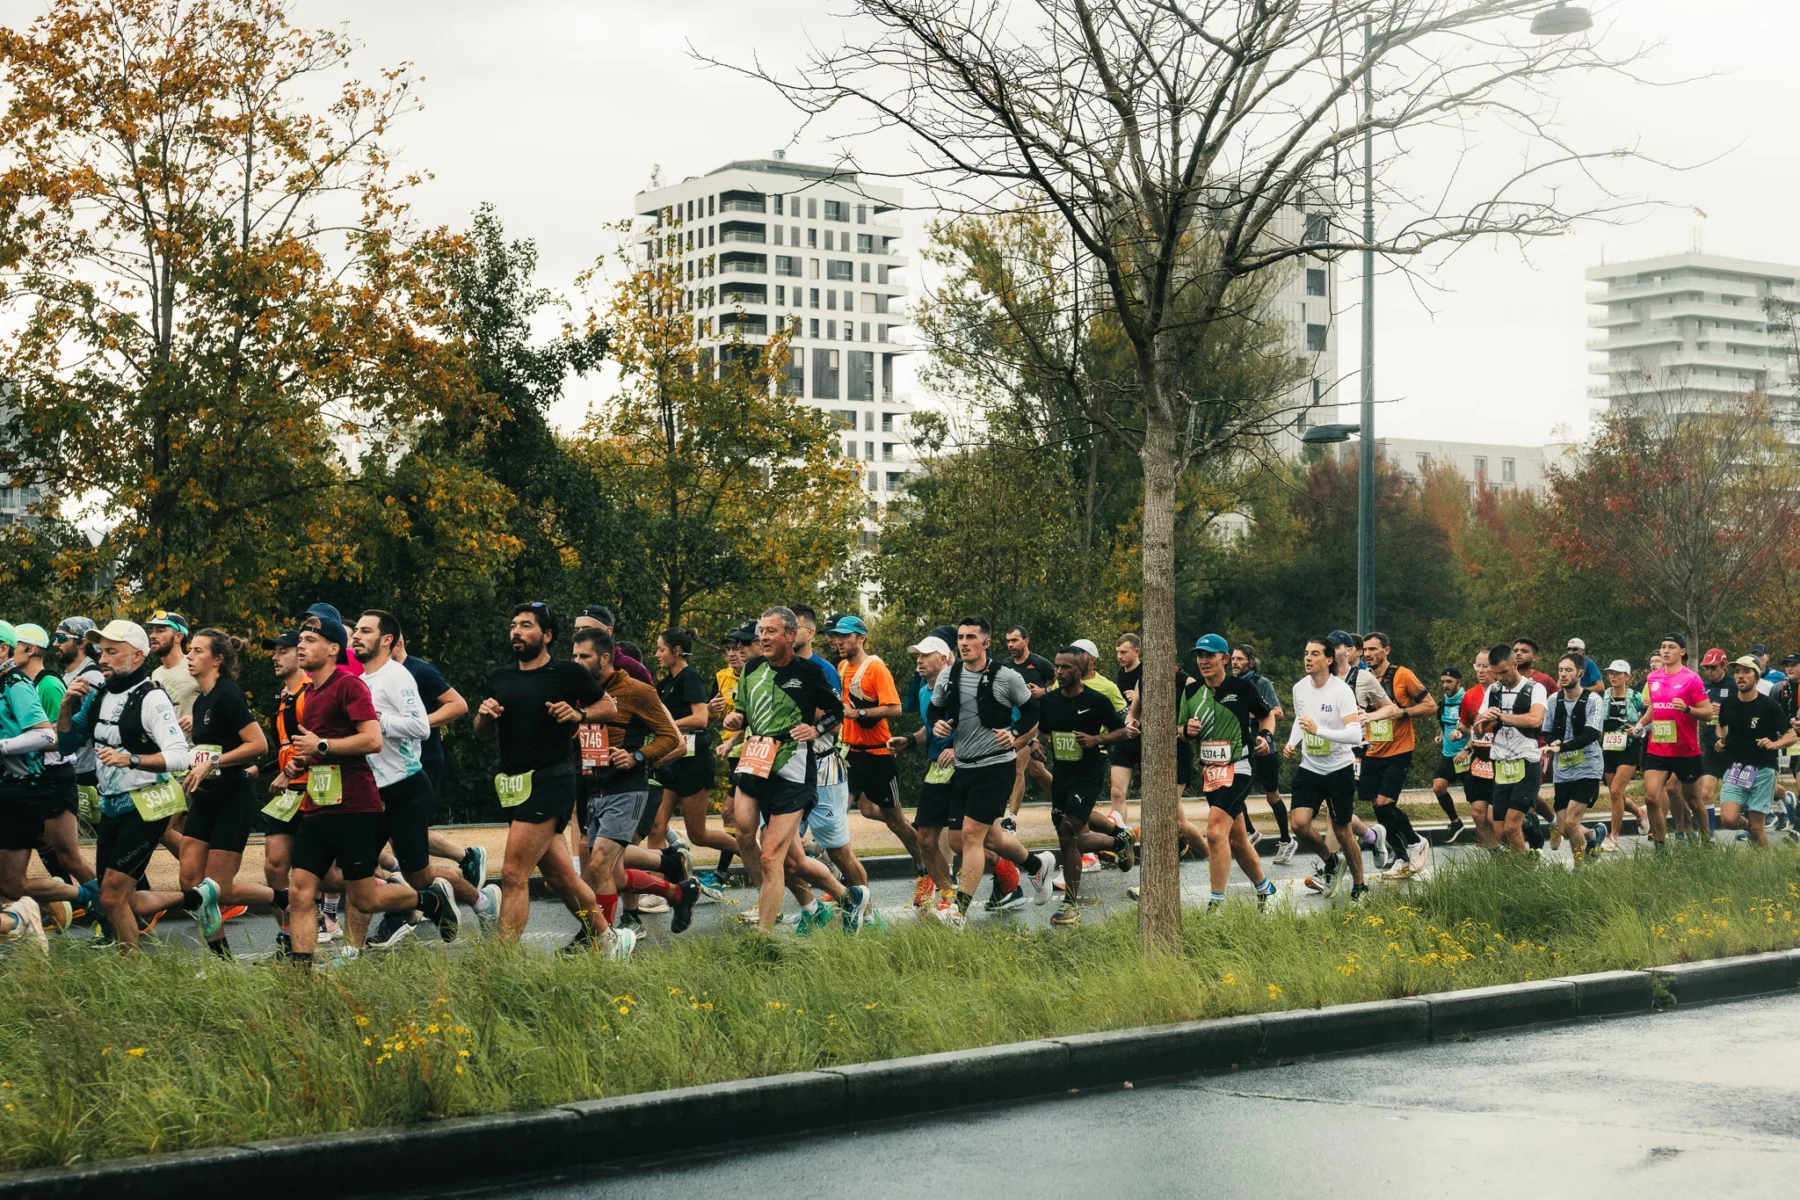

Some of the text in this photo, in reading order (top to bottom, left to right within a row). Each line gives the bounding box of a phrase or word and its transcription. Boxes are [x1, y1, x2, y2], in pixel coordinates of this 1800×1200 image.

[579, 731, 602, 749] 6746
[1056, 737, 1075, 751] 5712
[745, 741, 771, 759] 6370
[1201, 748, 1226, 759] 6374-A
[1206, 766, 1229, 782] 6374
[1501, 762, 1520, 775] 4913
[499, 774, 523, 794] 5140
[141, 784, 176, 809] 3947
